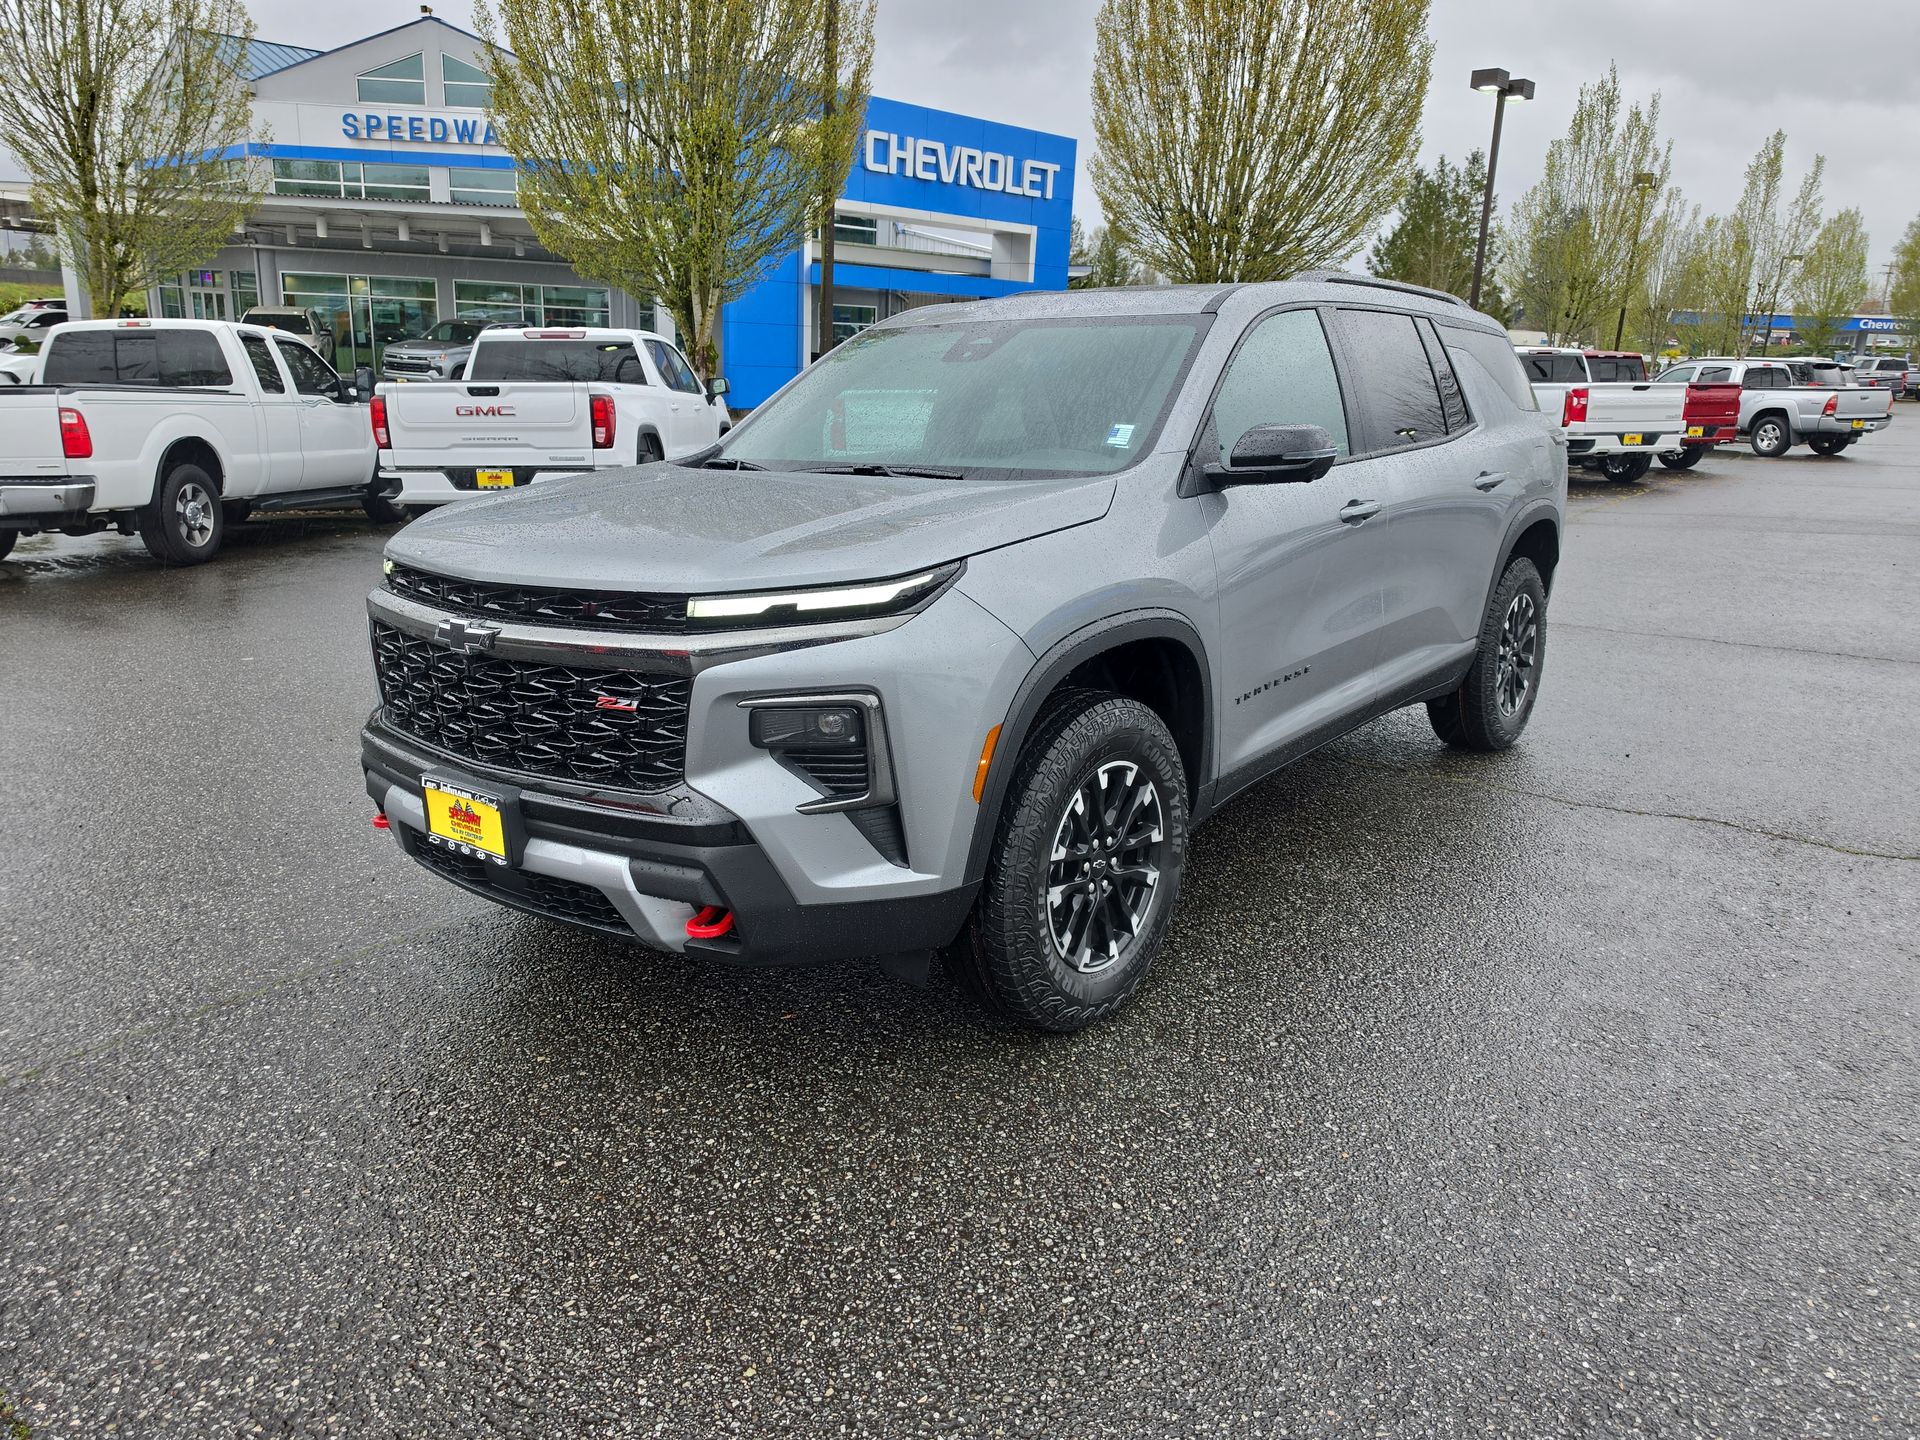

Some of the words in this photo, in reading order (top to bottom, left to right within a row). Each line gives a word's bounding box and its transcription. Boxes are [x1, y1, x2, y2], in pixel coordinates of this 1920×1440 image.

[342, 113, 497, 144] SPEEDWA
[865, 129, 1061, 200] CHEVROLET
[456, 406, 516, 416] GMC
[1235, 664, 1311, 705] TRAVERSE
[595, 696, 639, 711] Z71
[1036, 885, 1084, 1000] WRANGLER
